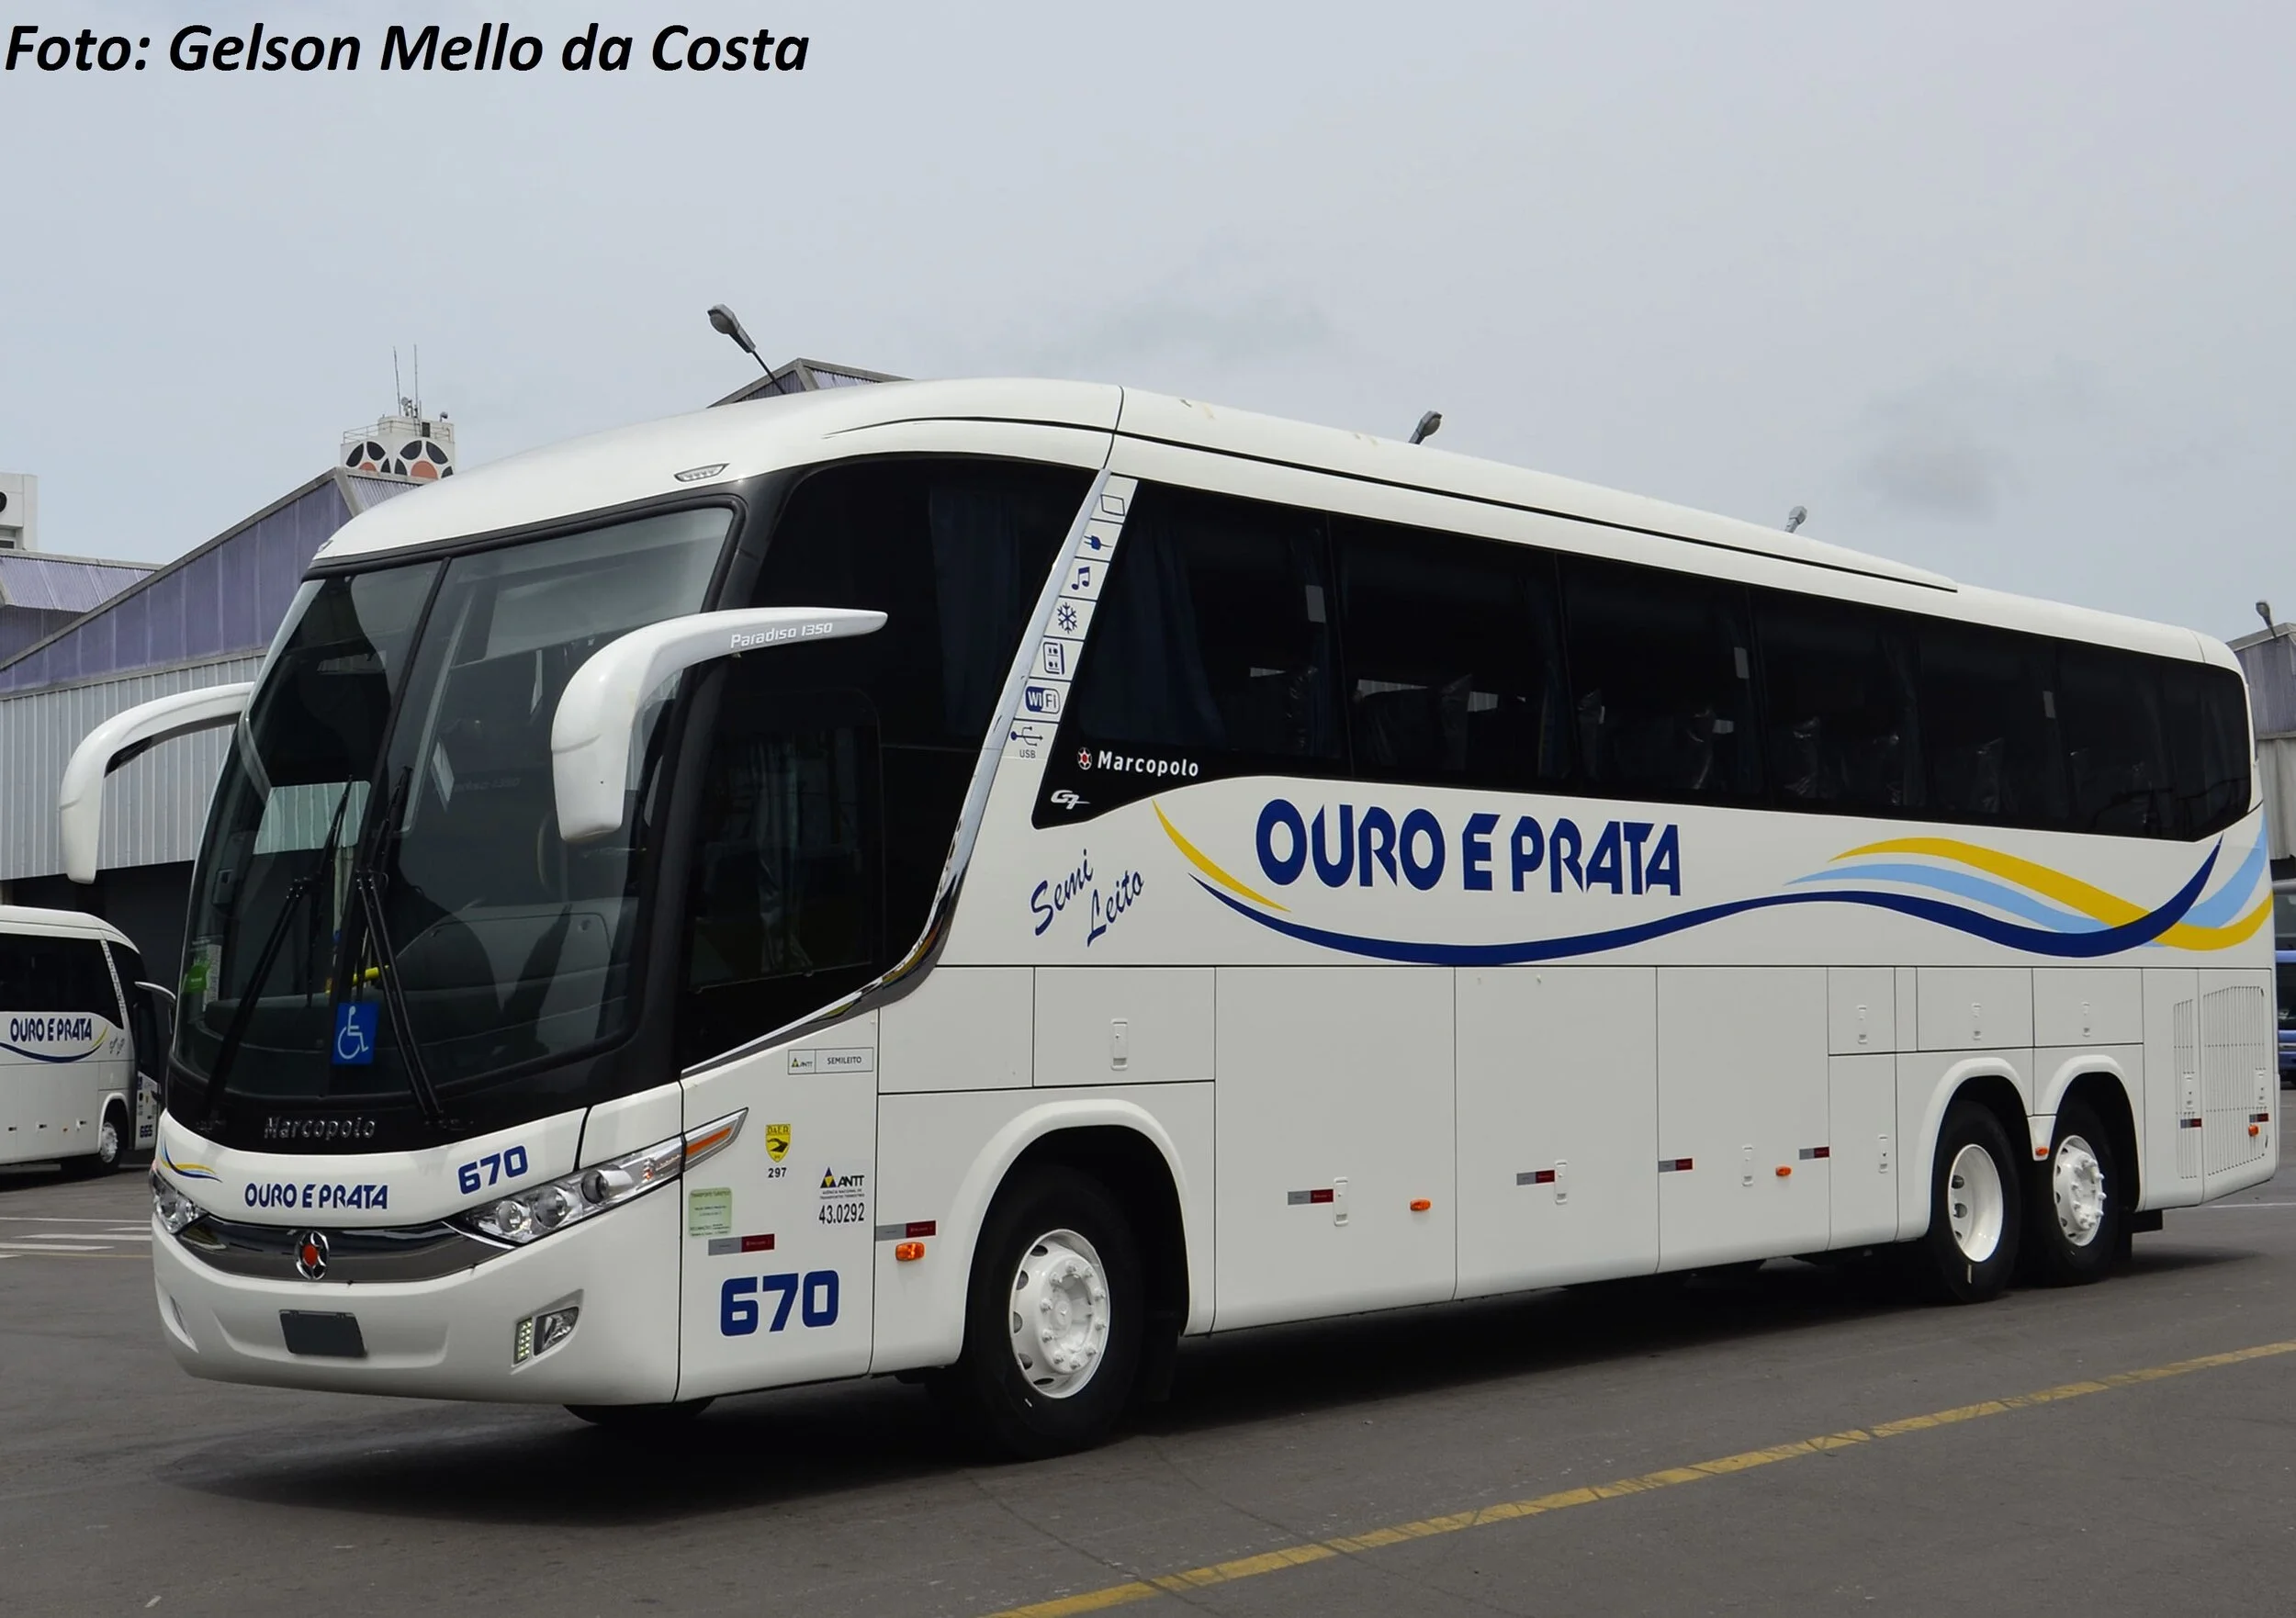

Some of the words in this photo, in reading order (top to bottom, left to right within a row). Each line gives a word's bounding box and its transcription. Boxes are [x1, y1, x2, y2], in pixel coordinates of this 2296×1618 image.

[731, 627, 796, 648] Paradiso
[802, 623, 833, 636] 1350
[1019, 749, 1036, 758] USB
[1097, 749, 1199, 777] Marcopolo
[1255, 798, 1446, 891] OURO
[1462, 813, 1501, 892] E
[1511, 815, 1681, 896] PRATA
[1030, 848, 1094, 936] Semi
[1087, 871, 1144, 948] Leito
[10, 1017, 44, 1041] OURO
[47, 1017, 55, 1041] E
[56, 1017, 92, 1041] PRATA
[827, 1056, 862, 1065] SEMILEITO
[264, 1117, 376, 1140] Marcopolo
[457, 1145, 528, 1195] 670
[768, 1167, 787, 1178] 297
[837, 1174, 865, 1187] ANTT
[244, 1184, 297, 1208] OURO
[301, 1184, 316, 1208] E
[319, 1185, 388, 1209] PRATA
[819, 1202, 865, 1224] 43.0292
[720, 1269, 839, 1338] 670
